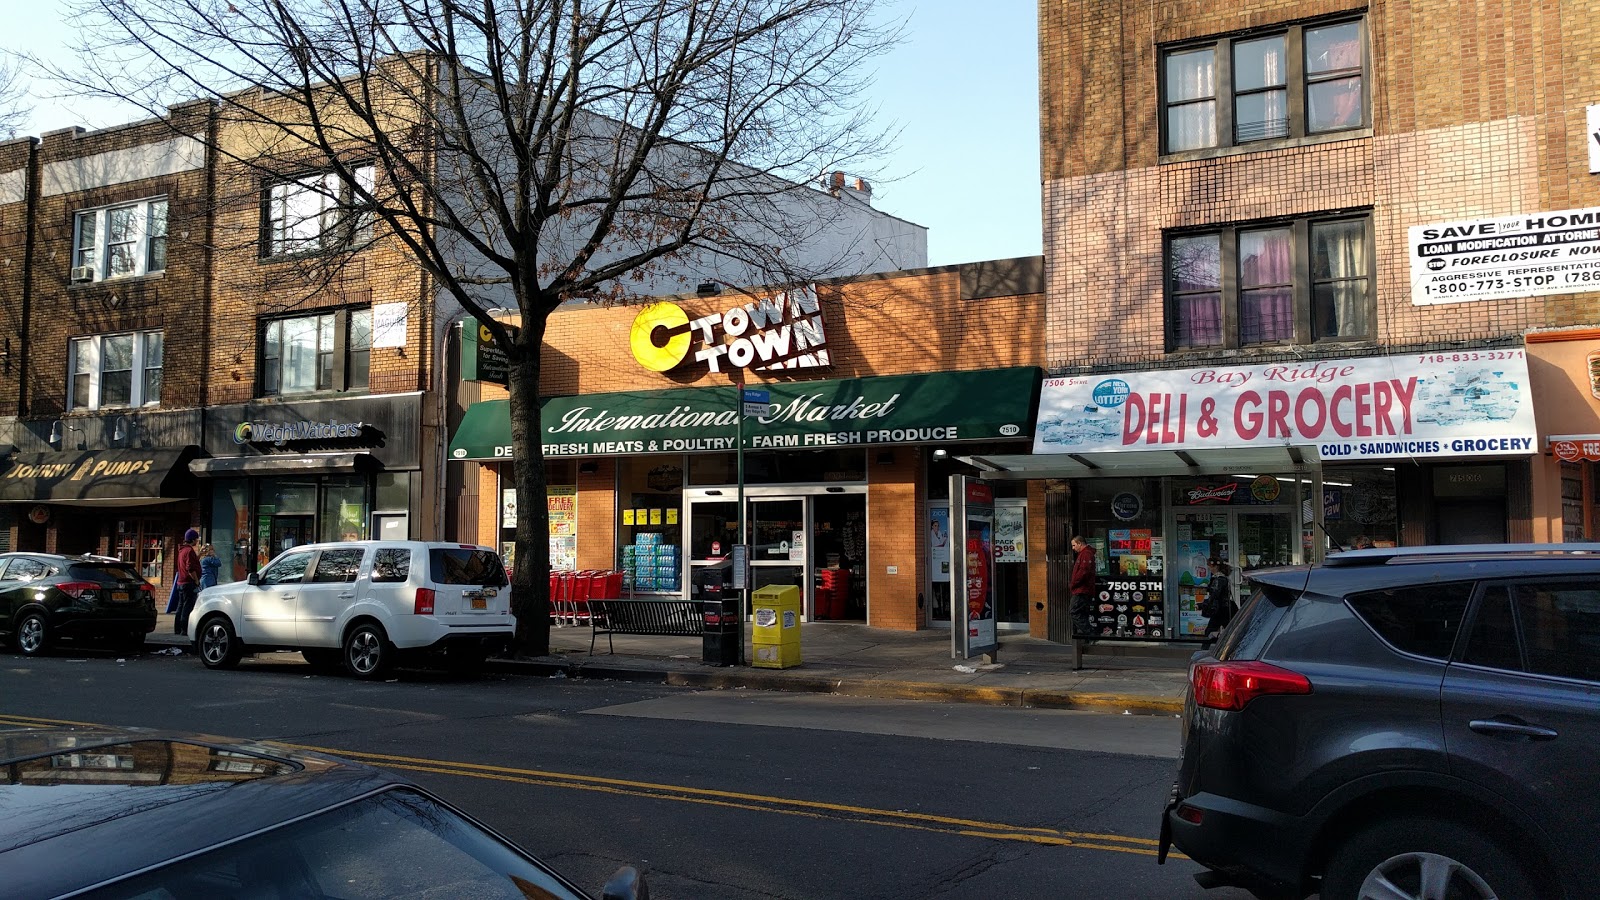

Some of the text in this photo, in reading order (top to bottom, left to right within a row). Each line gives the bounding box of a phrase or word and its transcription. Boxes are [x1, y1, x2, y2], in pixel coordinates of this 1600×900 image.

[1423, 212, 1600, 240] SAVE YOUR HOM
[1423, 229, 1600, 255] LOAN MODIFICATION ATTORNE
[1428, 260, 1446, 268] STOP
[1452, 249, 1561, 267] FORECLOSURE
[1425, 275, 1555, 295] 1-800-773-STOP
[1432, 271, 1502, 282] AGGRESSIVE
[690, 283, 820, 345] TOWN
[695, 315, 826, 373] TOWN
[1418, 350, 1524, 364] 718-833-3271
[1044, 379, 1065, 387] 7506
[1191, 362, 1355, 388] Bay Ridge
[1094, 394, 1129, 405] LOTTERY
[548, 393, 900, 433] Internationa Market
[1122, 376, 1418, 446] DELI & GROCERY
[1001, 425, 1017, 433] 7510
[495, 426, 957, 457] DE FRESH MEATS & POULTRY FARM FRESH PRODUCE
[1321, 437, 1532, 456] COLD SANDWICHES GROCERY
[7, 459, 154, 478] JOHNNY PUMPS
[549, 503, 574, 511] DELIVERY
[1107, 581, 1137, 591] 7506
[1139, 581, 1163, 591] 5TH
